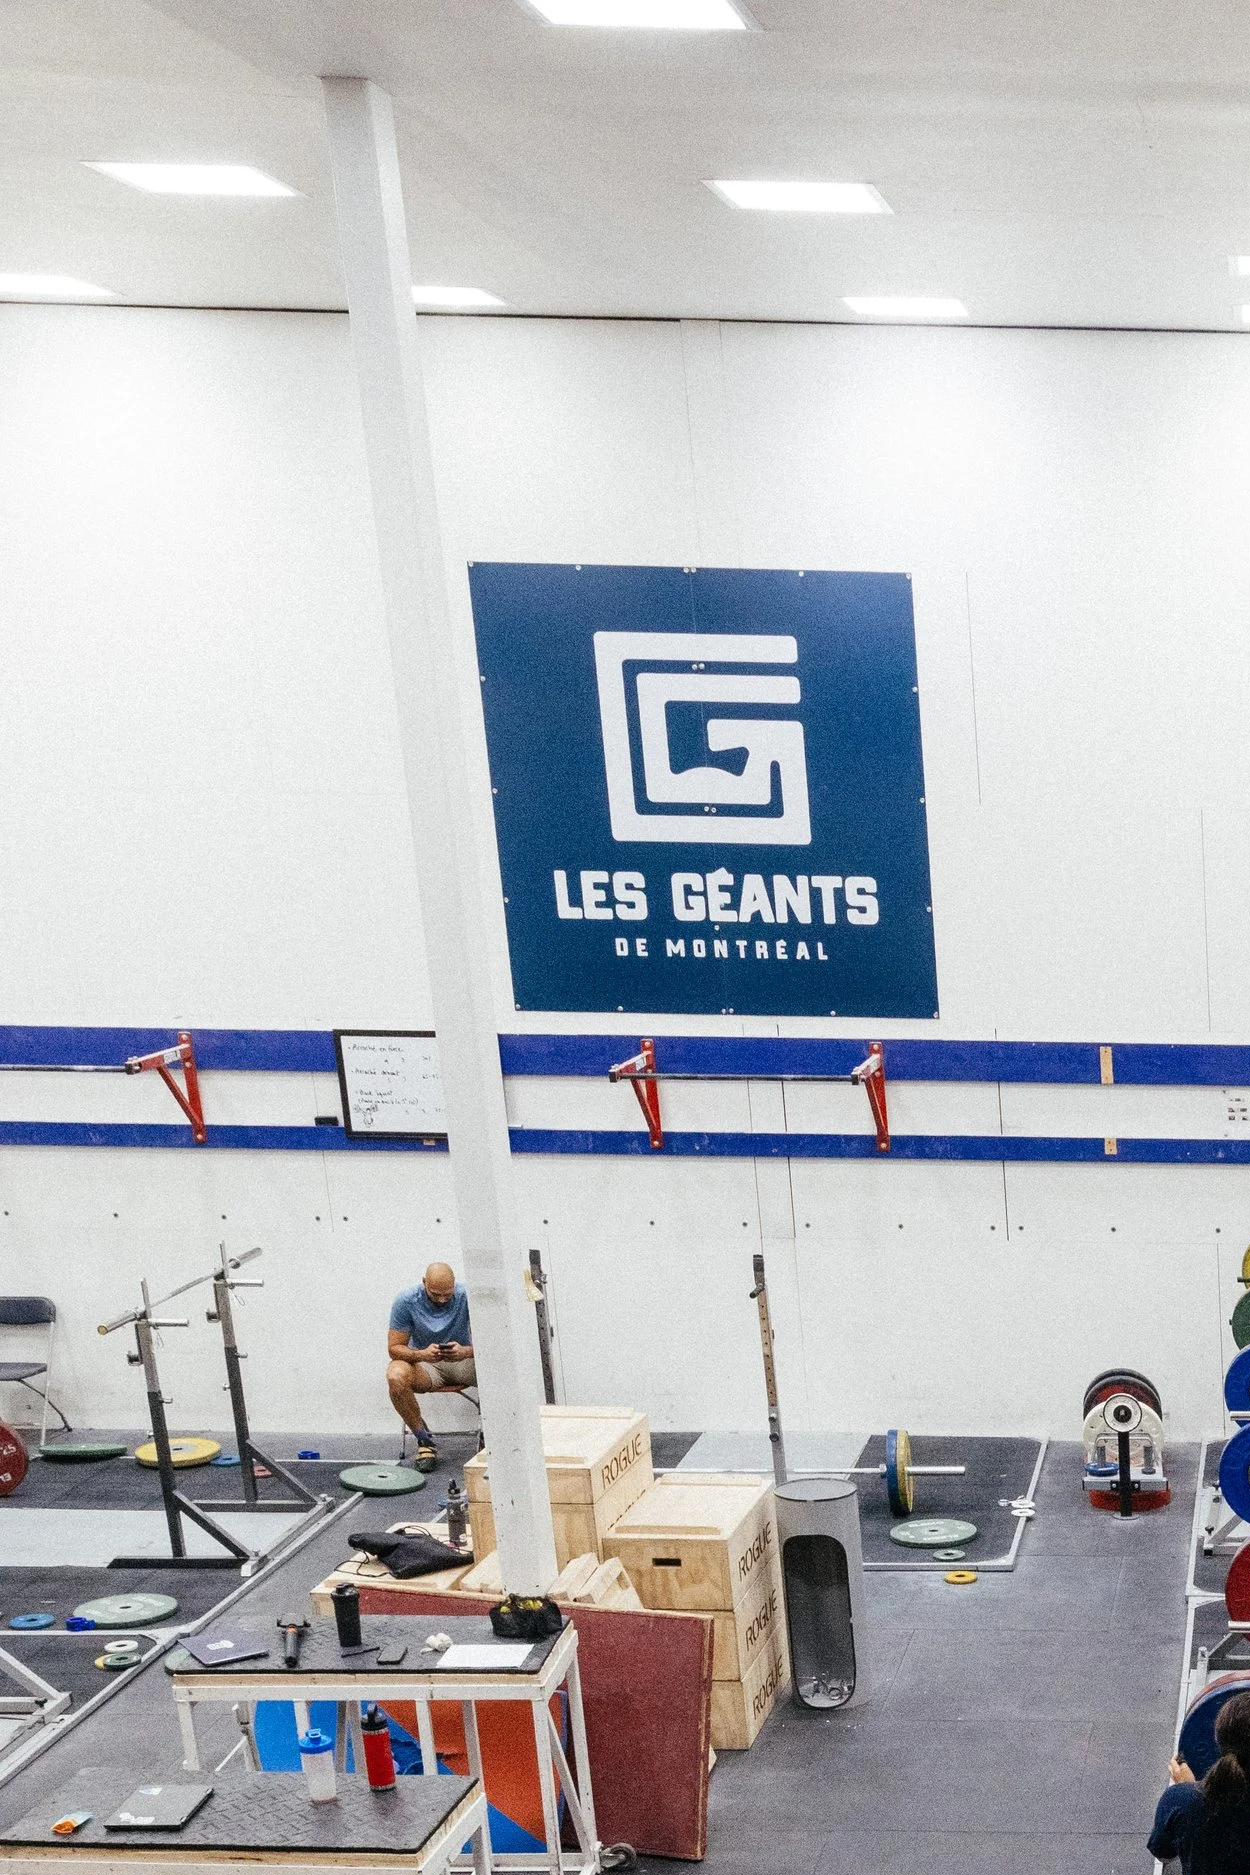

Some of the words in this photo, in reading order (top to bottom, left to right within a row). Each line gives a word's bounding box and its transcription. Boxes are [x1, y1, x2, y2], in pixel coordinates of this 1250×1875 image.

[553, 869, 649, 920] LES
[670, 867, 880, 925] GÉANTS
[615, 937, 649, 957] DE
[665, 938, 829, 961] MONTRÉAL
[601, 1432, 642, 1491] ROGUE
[738, 1520, 772, 1583] ROGUE
[745, 1588, 778, 1652] ROGUE
[752, 1654, 785, 1721] ROGUE
